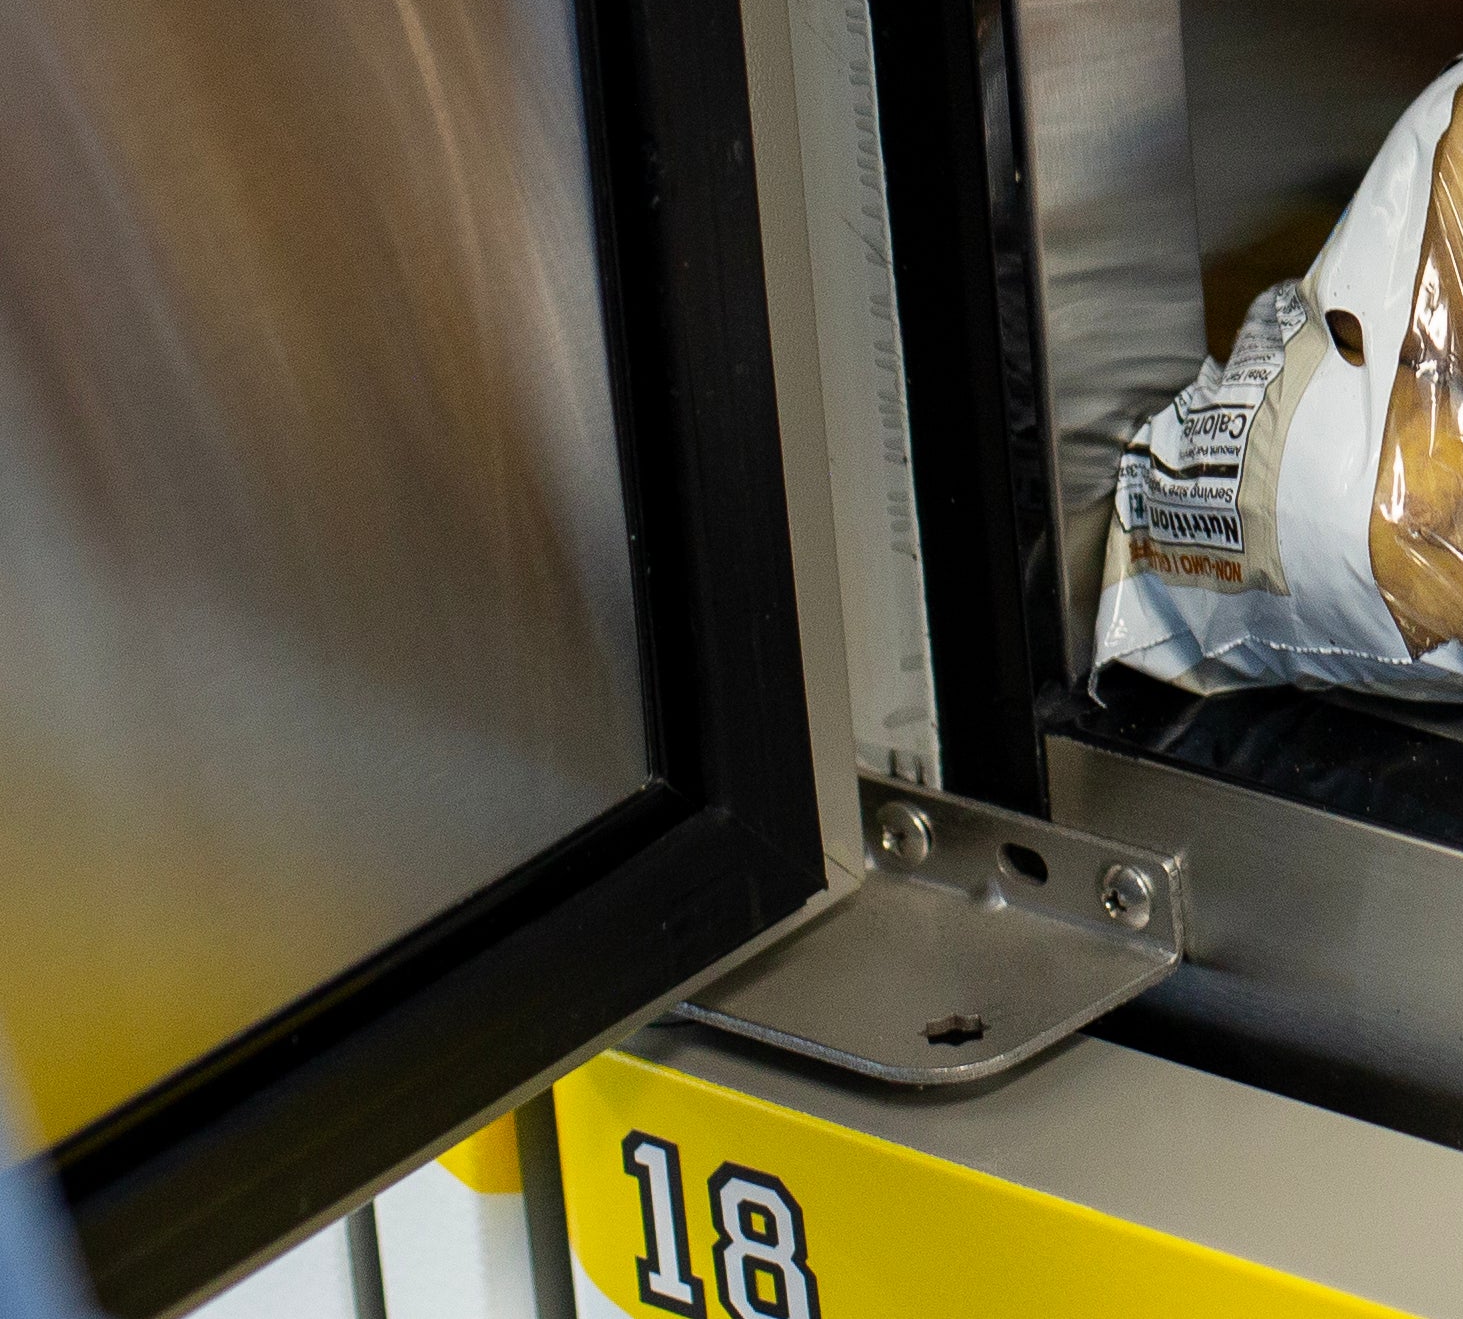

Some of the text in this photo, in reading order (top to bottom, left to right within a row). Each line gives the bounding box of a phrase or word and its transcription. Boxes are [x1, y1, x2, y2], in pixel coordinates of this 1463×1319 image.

[1183, 412, 1247, 442] Calorie
[1209, 445, 1242, 457] Amount
[1189, 480, 1234, 503] Serving
[1149, 506, 1240, 545] Nutrition
[621, 1128, 823, 1319] 18
